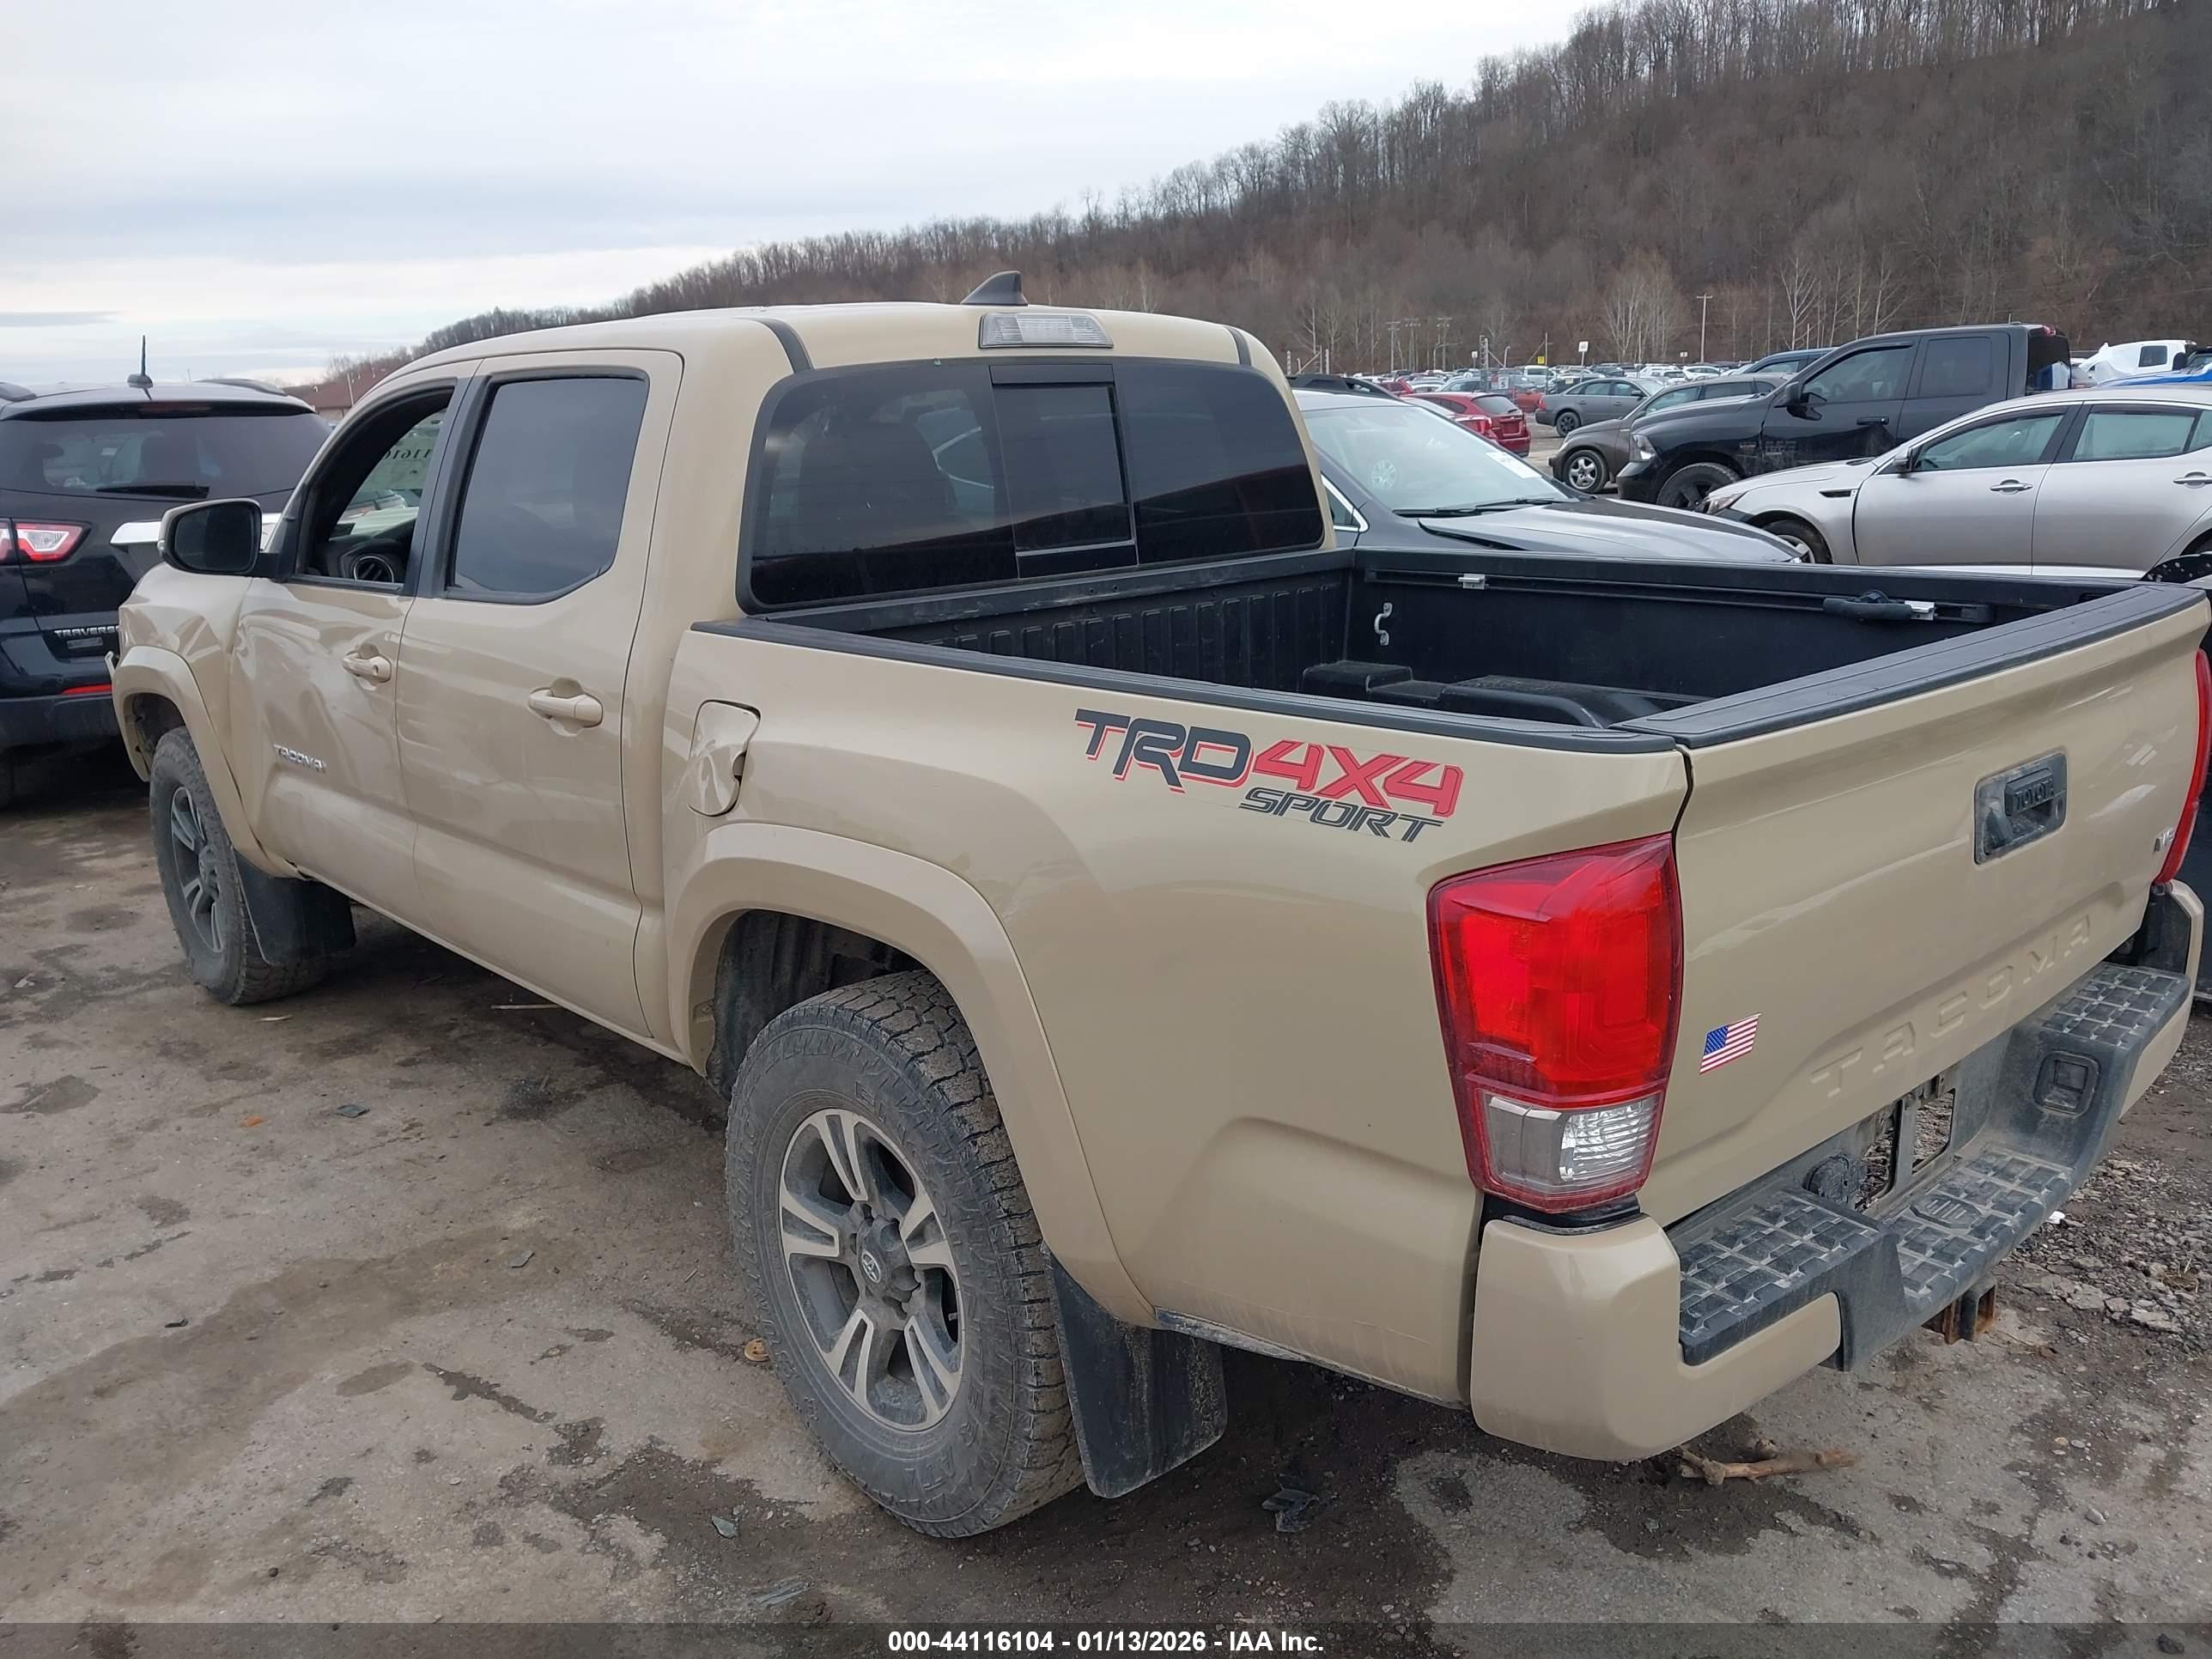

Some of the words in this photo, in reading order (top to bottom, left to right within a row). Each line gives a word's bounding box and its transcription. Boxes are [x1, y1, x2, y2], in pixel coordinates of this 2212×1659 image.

[273, 743, 325, 770] TACOMA
[1074, 708, 1254, 793] TRD
[1250, 738, 1464, 818] 4X4
[1238, 786, 1445, 843] SPORT
[2014, 777, 2054, 811] TOYOTA
[1810, 915, 2091, 1098] TACOMA
